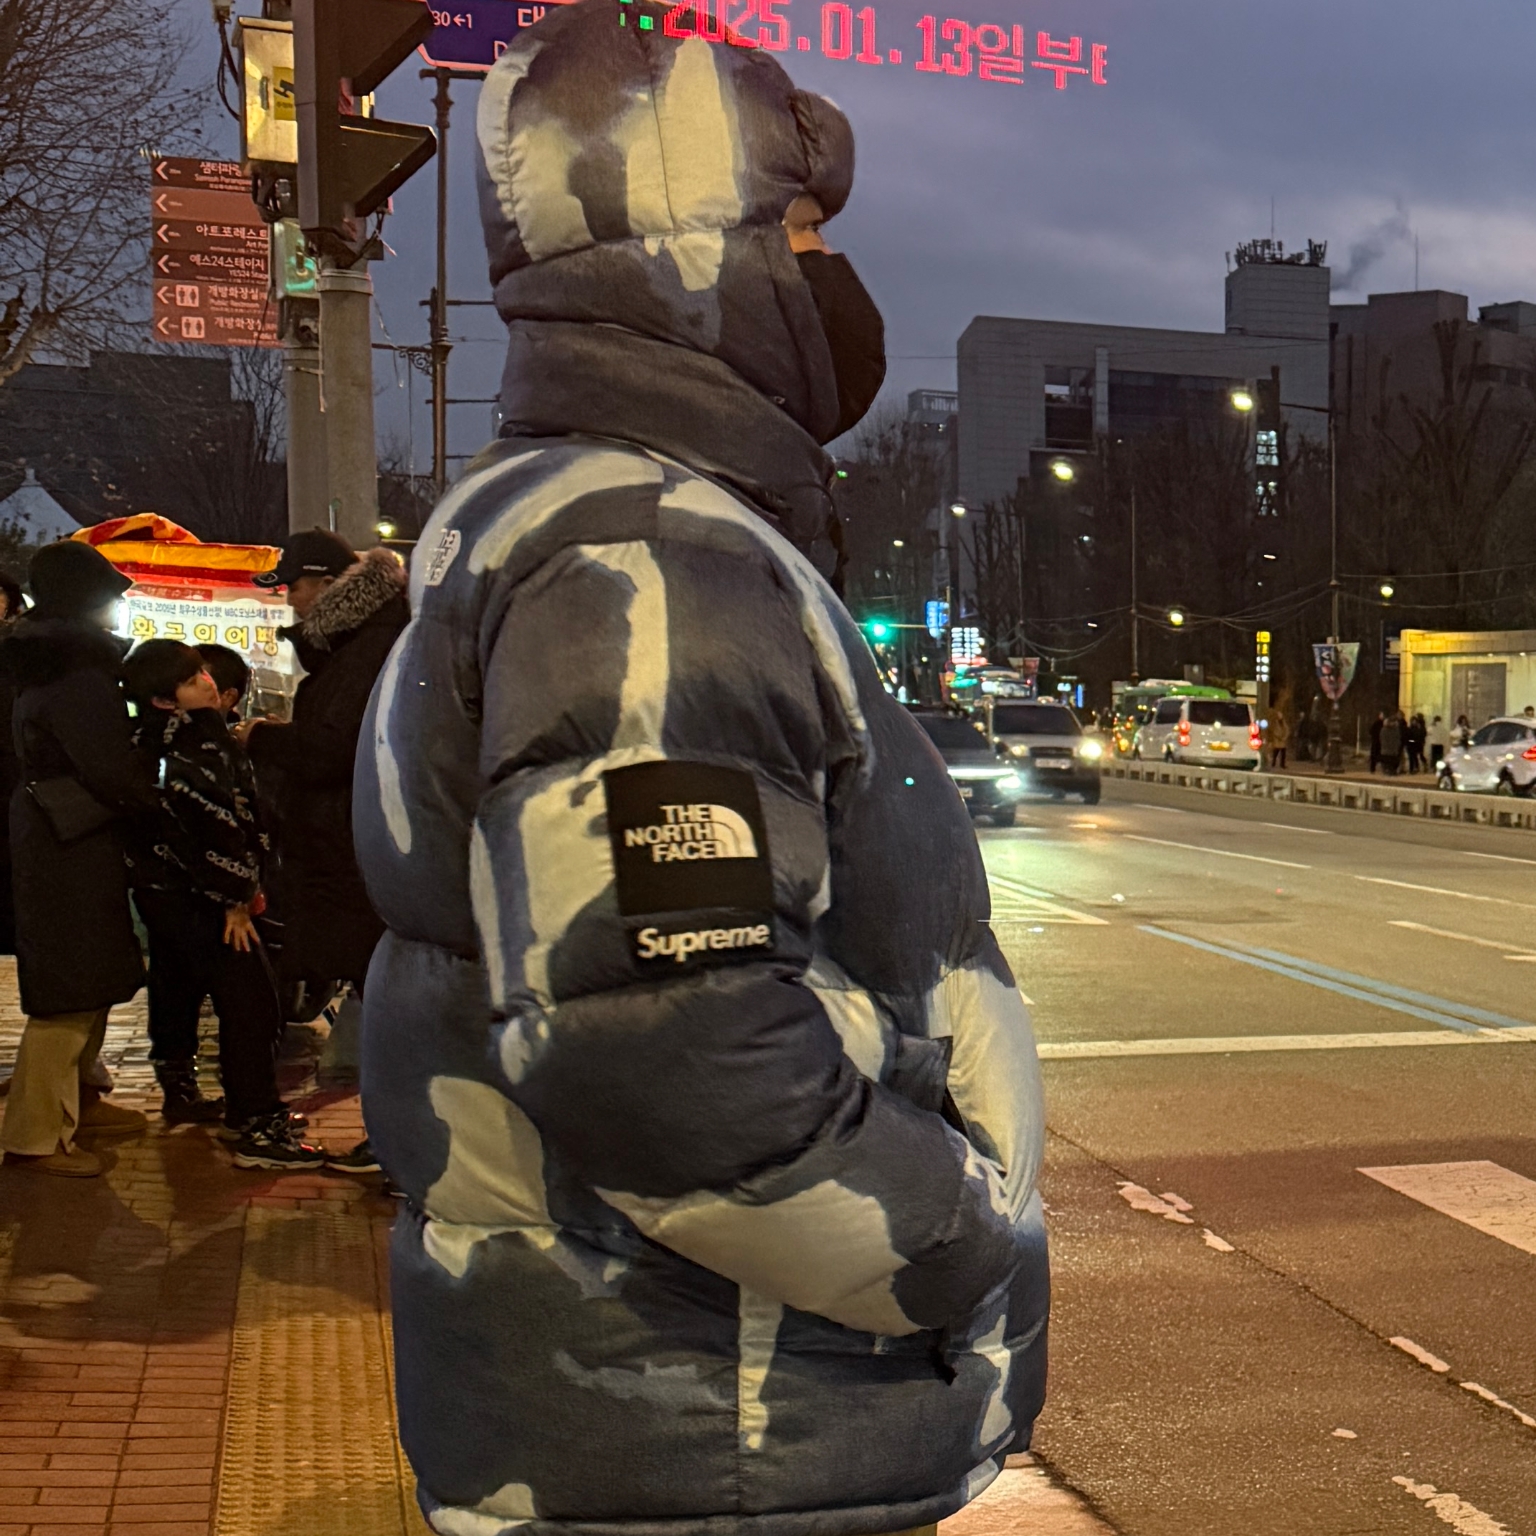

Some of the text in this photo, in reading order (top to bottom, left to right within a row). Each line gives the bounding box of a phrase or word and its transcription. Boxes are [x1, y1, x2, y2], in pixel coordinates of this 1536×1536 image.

[660, 804, 710, 823] THE
[624, 822, 713, 847] NORTH
[652, 840, 717, 863] FACE
[636, 923, 770, 962] Supreme
